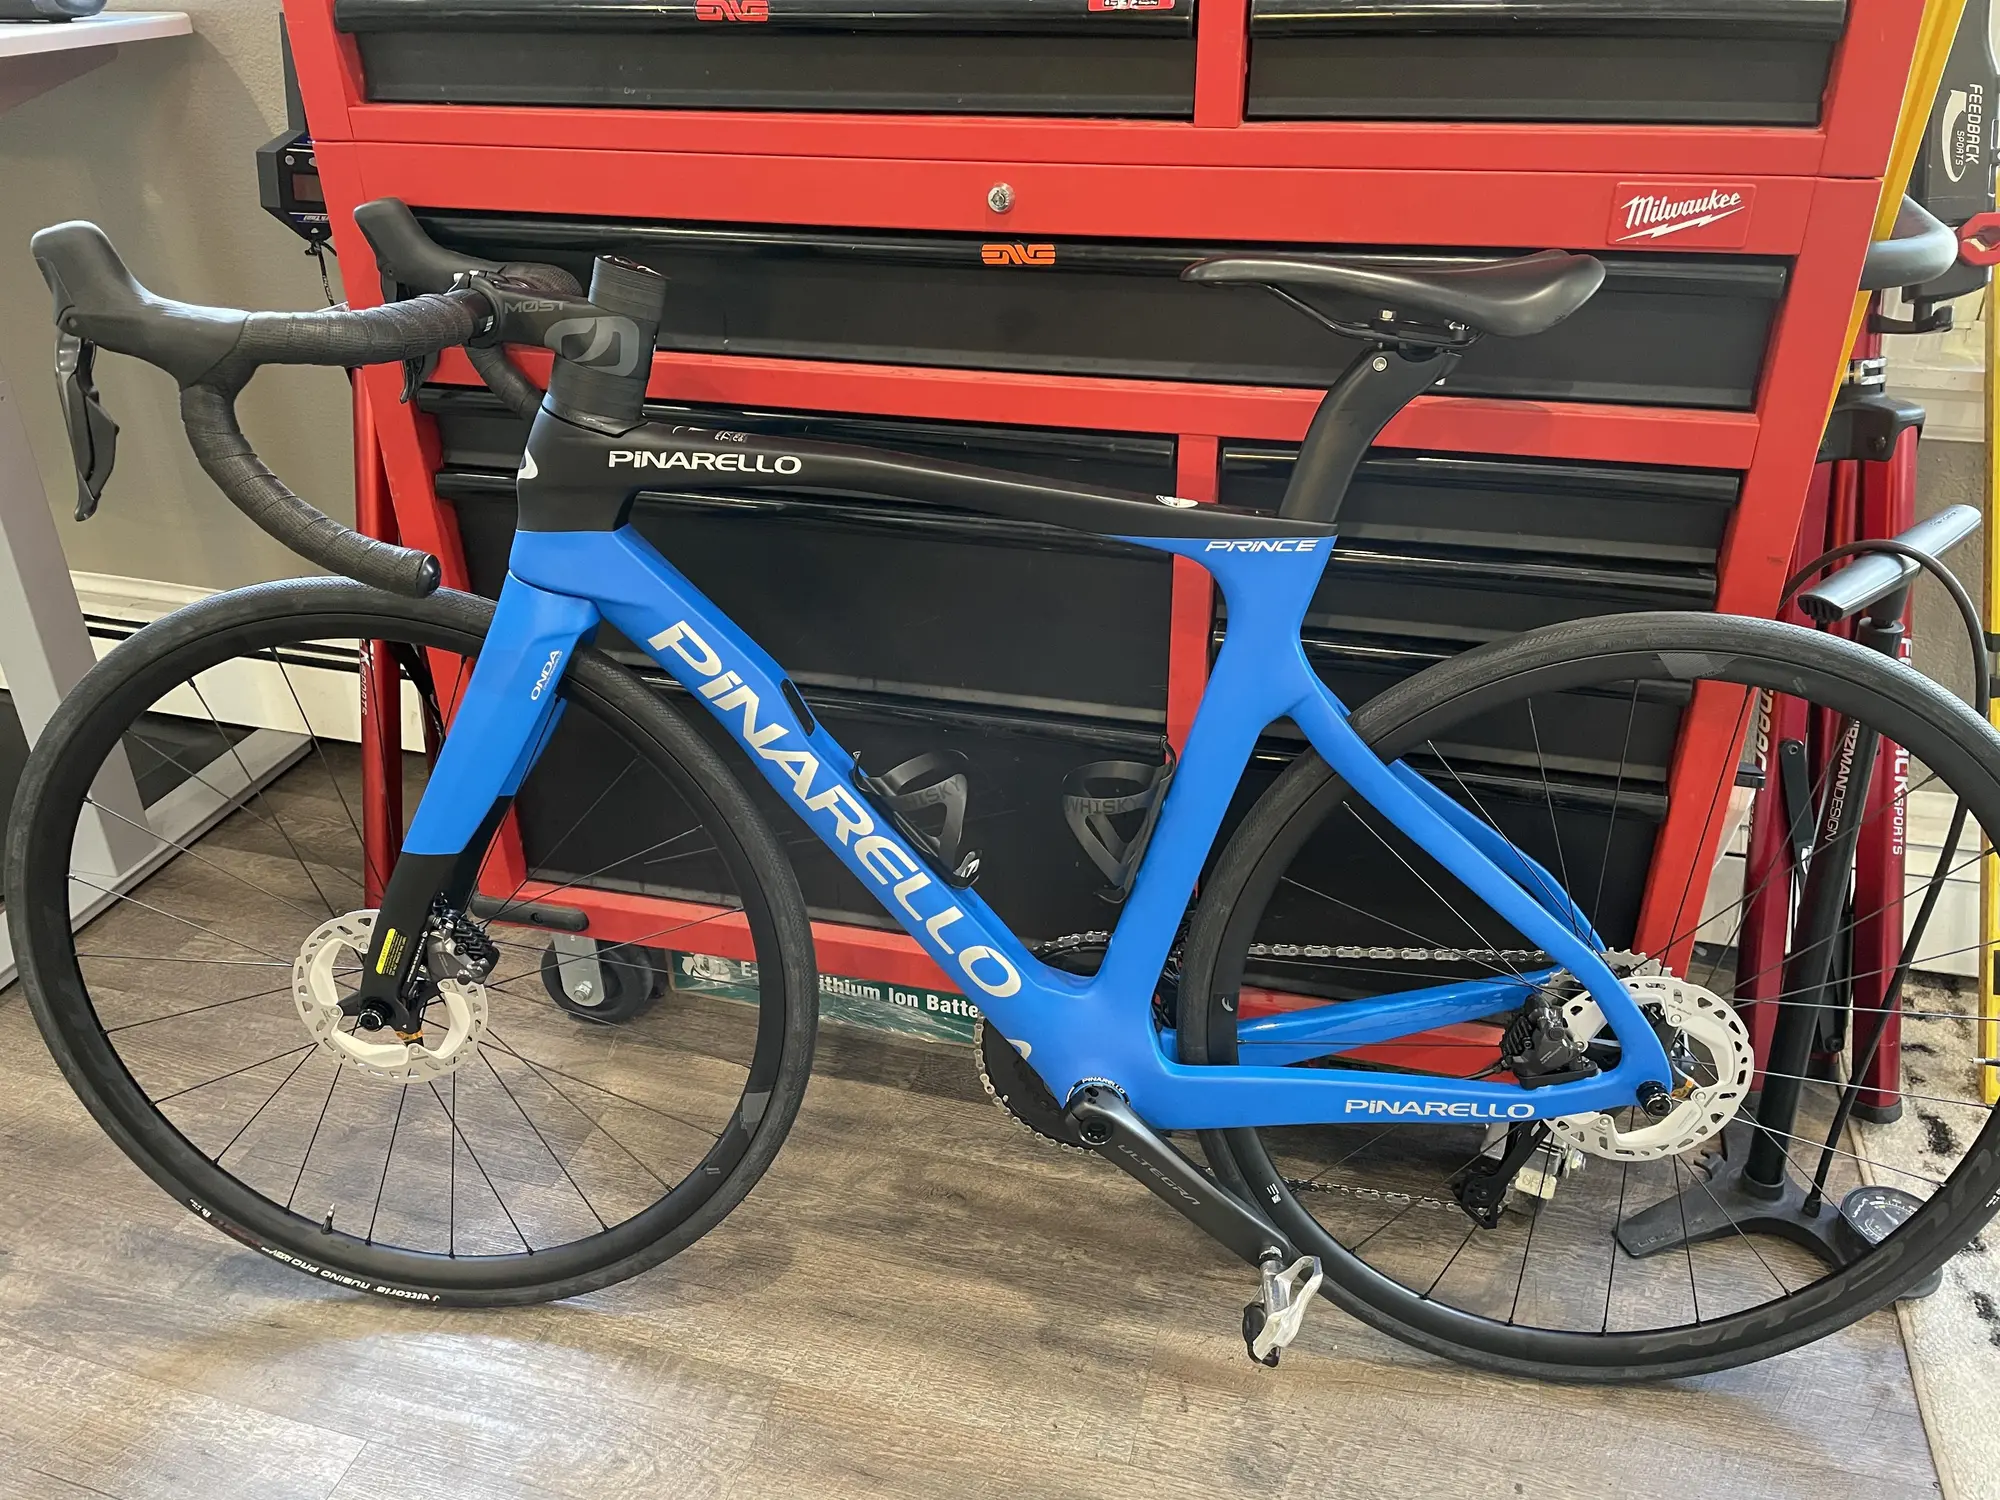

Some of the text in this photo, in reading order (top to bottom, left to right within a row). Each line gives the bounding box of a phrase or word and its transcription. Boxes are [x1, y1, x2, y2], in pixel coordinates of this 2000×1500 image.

[1965, 83, 1983, 165] FEEDBACK
[1955, 130, 1965, 166] SPORTS
[1620, 188, 1742, 229] Milwaukee
[530, 650, 560, 701] ONDA
[888, 986, 919, 1009] Ion
[926, 993, 978, 1018] Batte
[1117, 1144, 1201, 1206] ULTEGRA
[374, 1285, 431, 1301] vittoria
